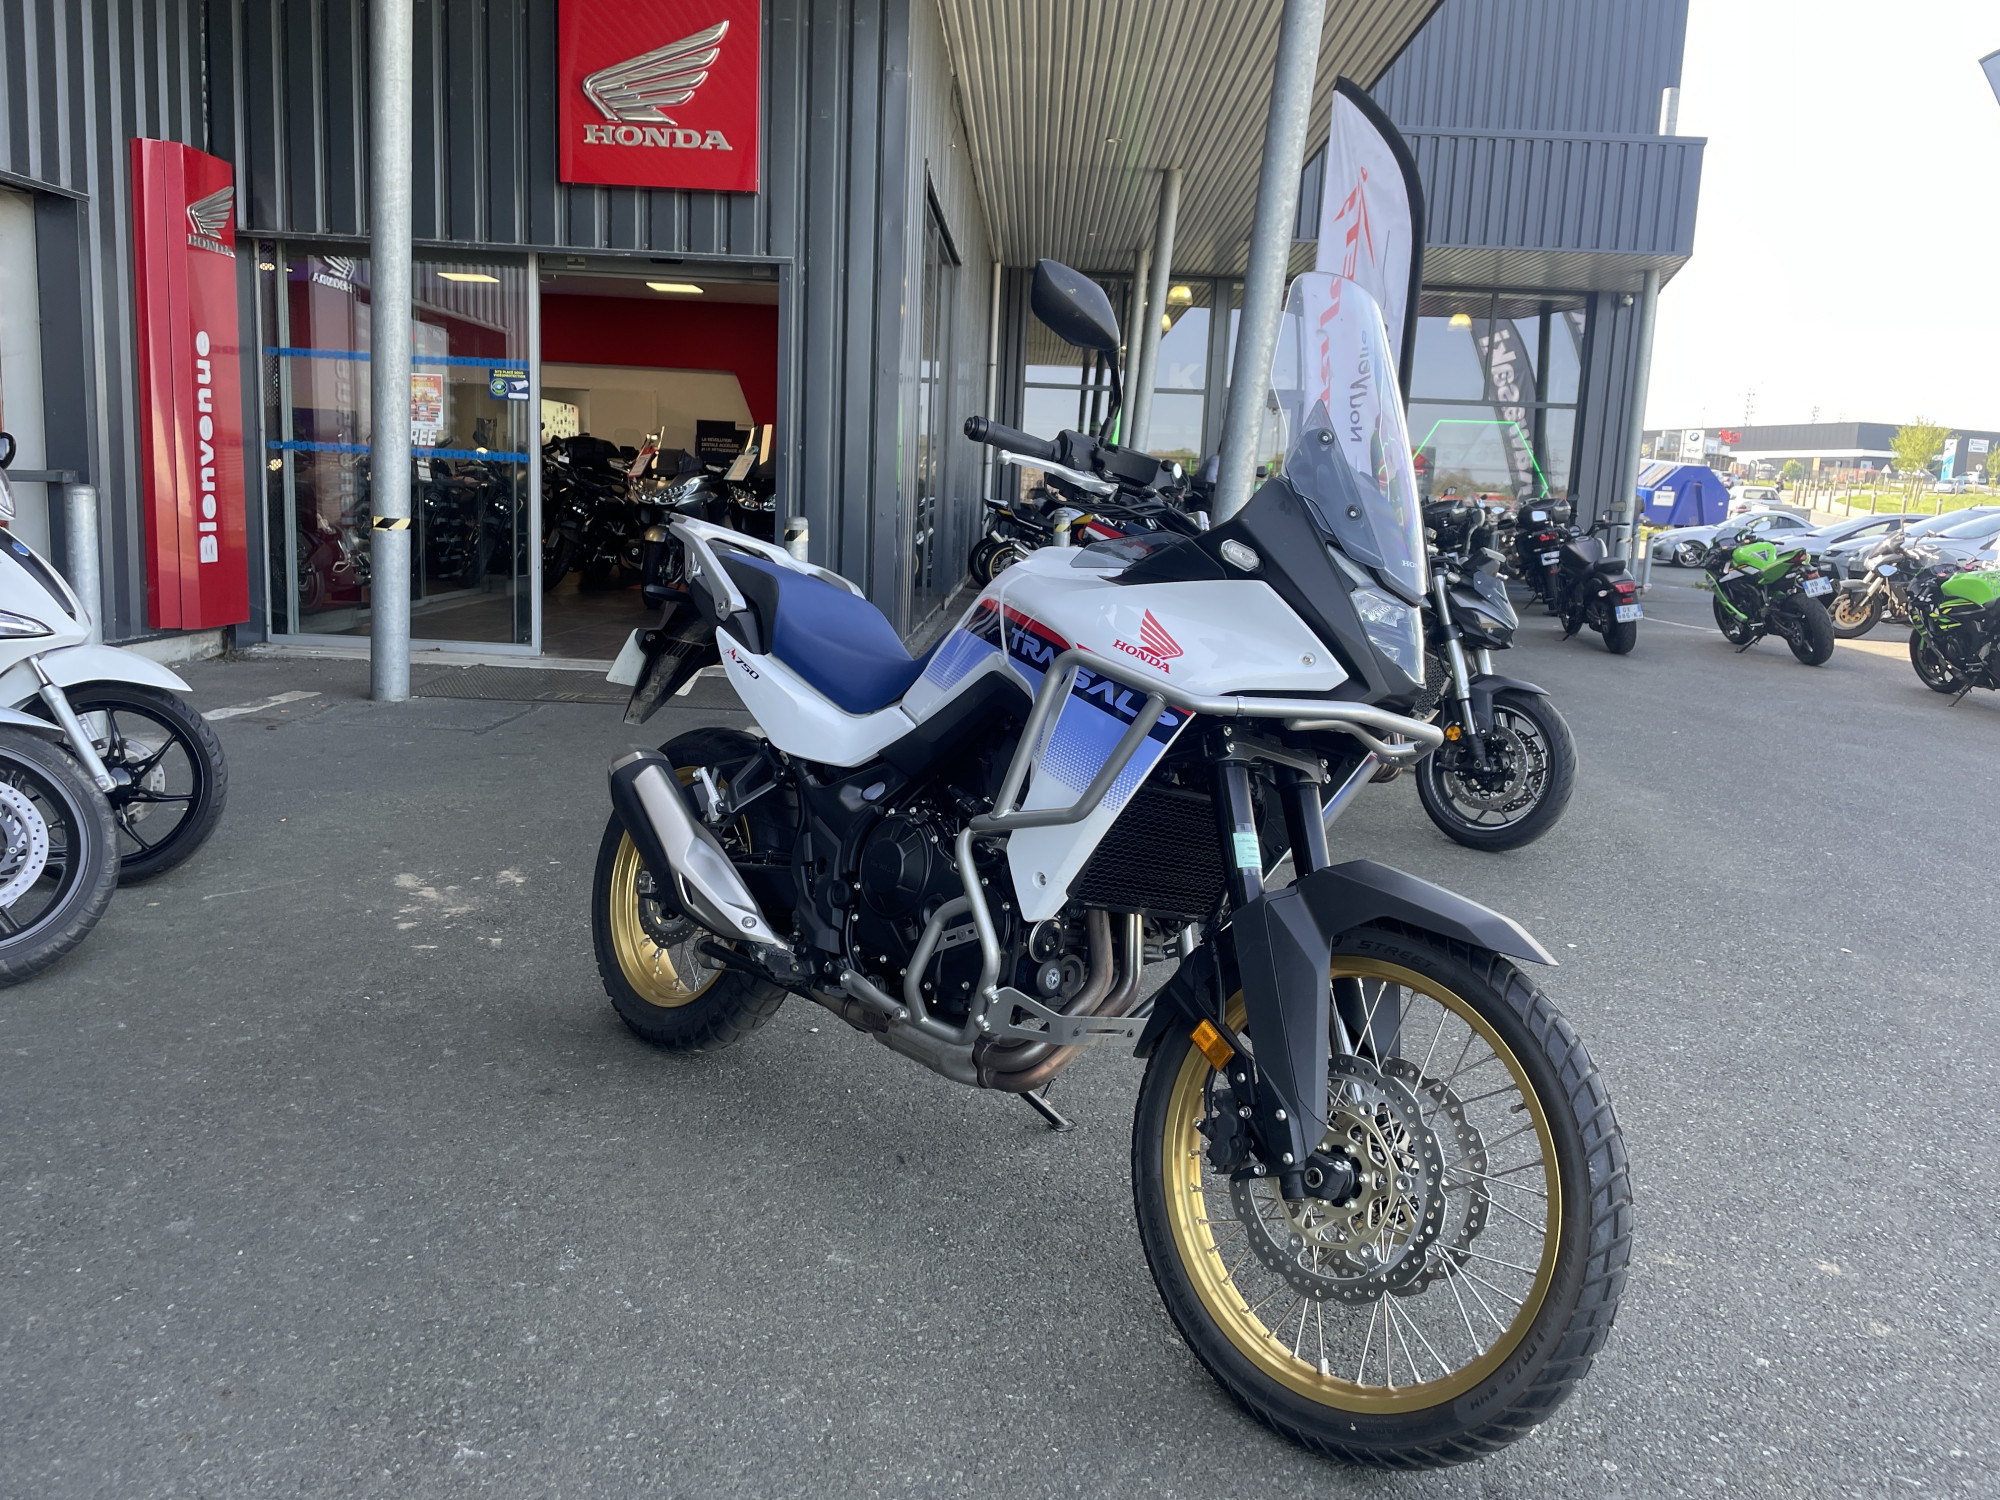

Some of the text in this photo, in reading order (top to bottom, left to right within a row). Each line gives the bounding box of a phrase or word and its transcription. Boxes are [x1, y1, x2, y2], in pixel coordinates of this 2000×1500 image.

[583, 124, 733, 151] HONDA
[187, 233, 236, 258] HONDA
[196, 331, 218, 563] Bienvenue
[411, 430, 437, 446] REE
[735, 656, 760, 680] 750
[1112, 639, 1171, 674] HONDA
[1011, 627, 1179, 727] TRASAL
[1357, 940, 1437, 969] STREET
